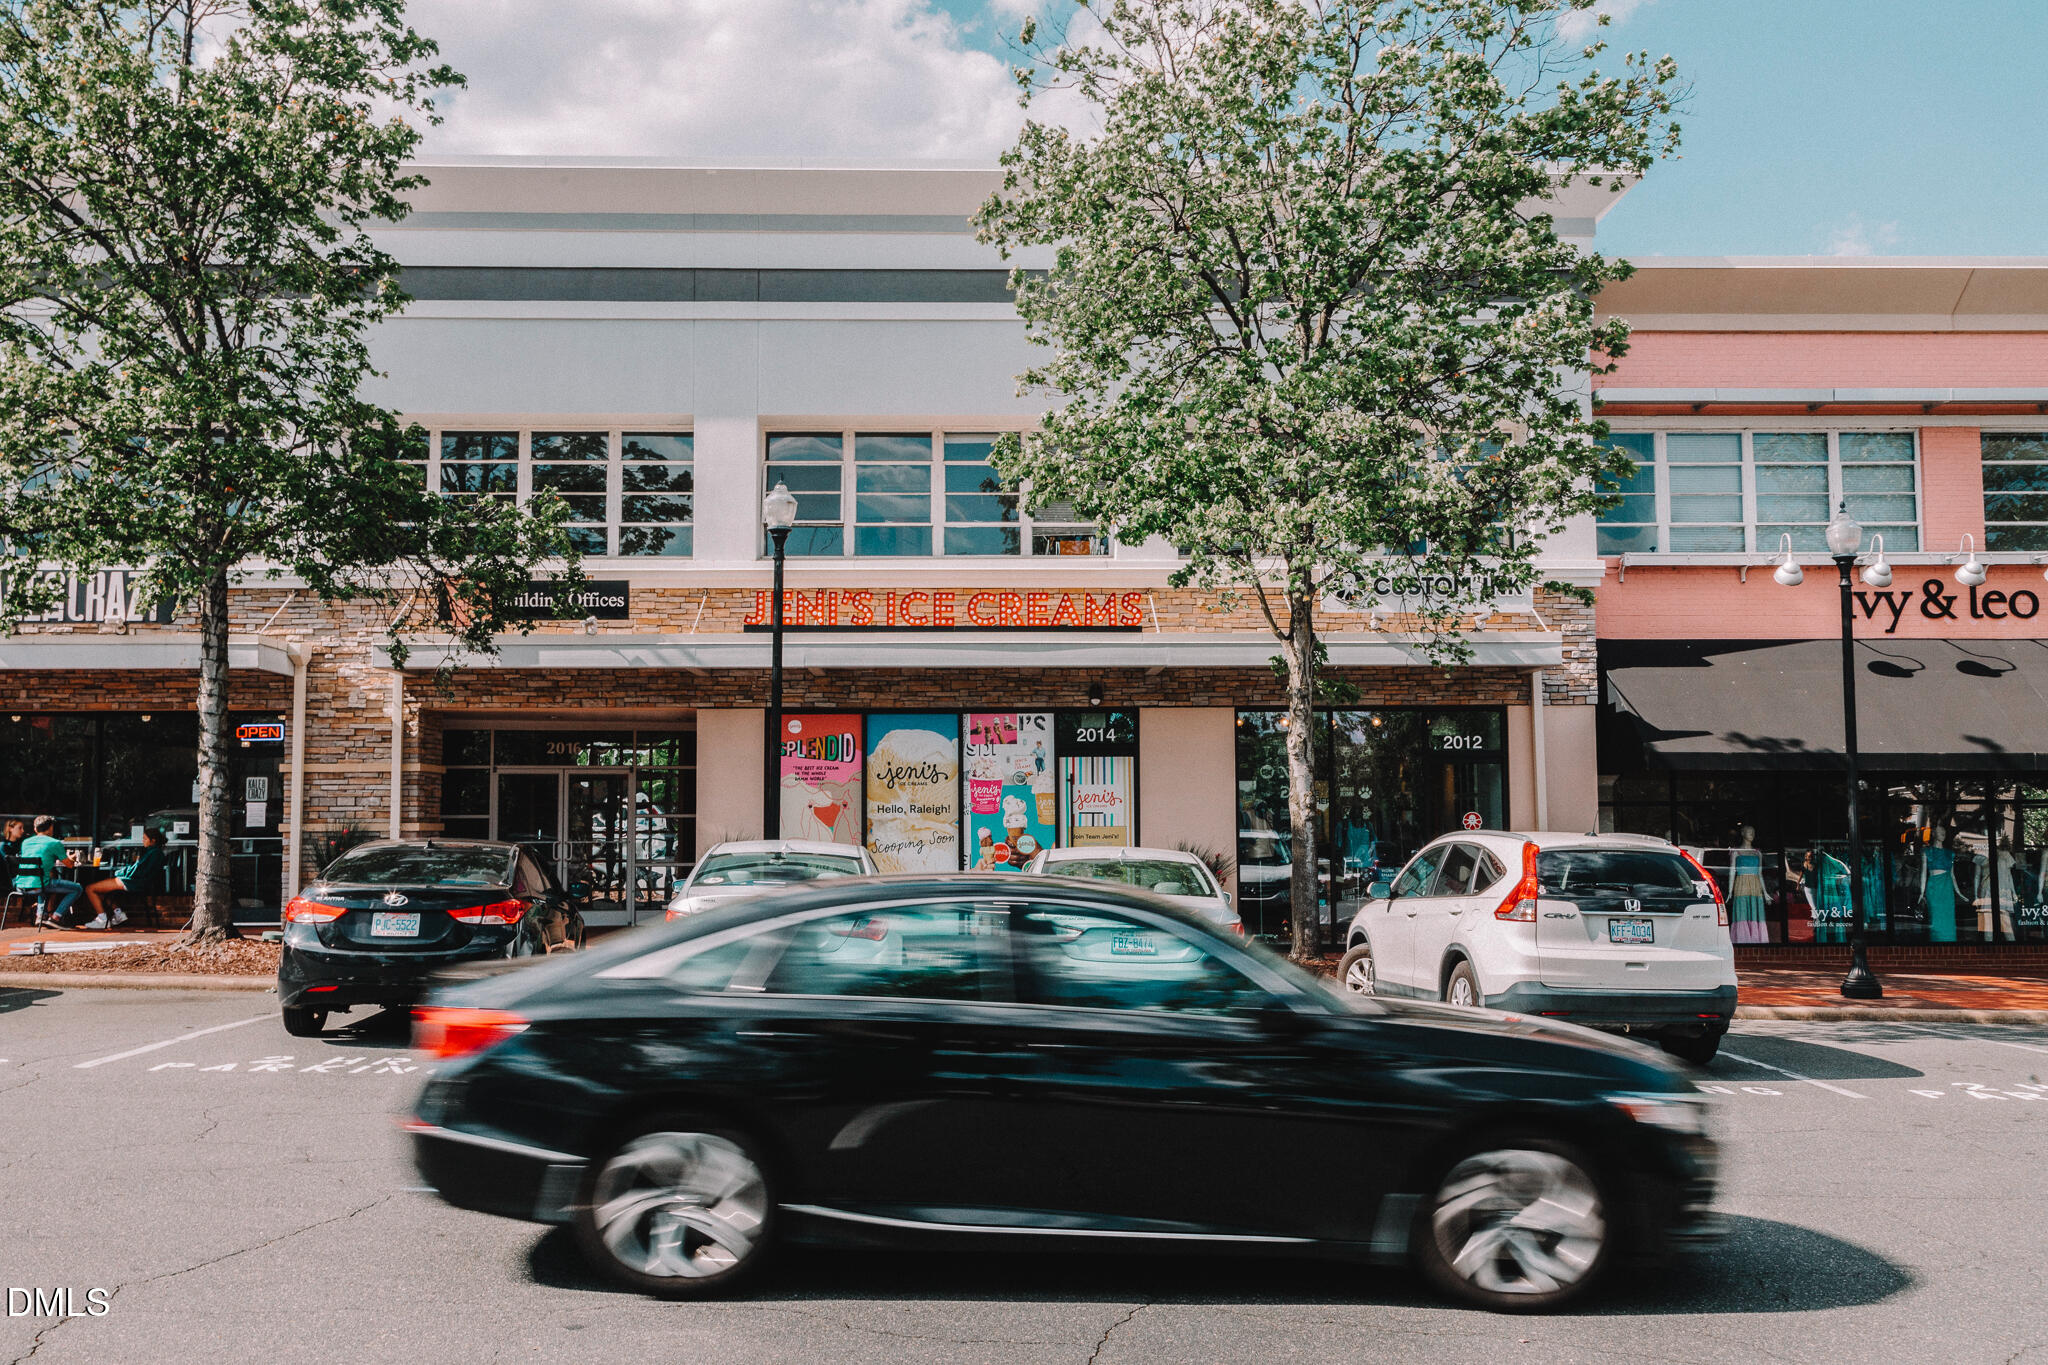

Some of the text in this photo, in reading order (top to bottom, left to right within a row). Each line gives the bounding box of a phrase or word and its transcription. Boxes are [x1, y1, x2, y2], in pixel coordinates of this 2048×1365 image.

[568, 592, 625, 608] Offices
[1852, 579, 2040, 633] vy & leo
[744, 591, 1142, 626] JENI'S ICE CREAMS
[236, 726, 280, 739] OPEN
[1076, 728, 1116, 742] 2014
[546, 741, 581, 755] 2016
[1443, 735, 1483, 750] 2012
[876, 761, 949, 789] jeni's
[1072, 789, 1123, 811] jeni's
[877, 804, 951, 816] Hello, Raleigh!
[871, 830, 955, 855] Scooping Soon
[1830, 906, 1841, 918] &
[2021, 905, 2040, 920] ivy
[375, 918, 417, 931] PJC-5522
[1611, 925, 1652, 938] KFF-4034
[149, 1062, 437, 1074] PARKIN
